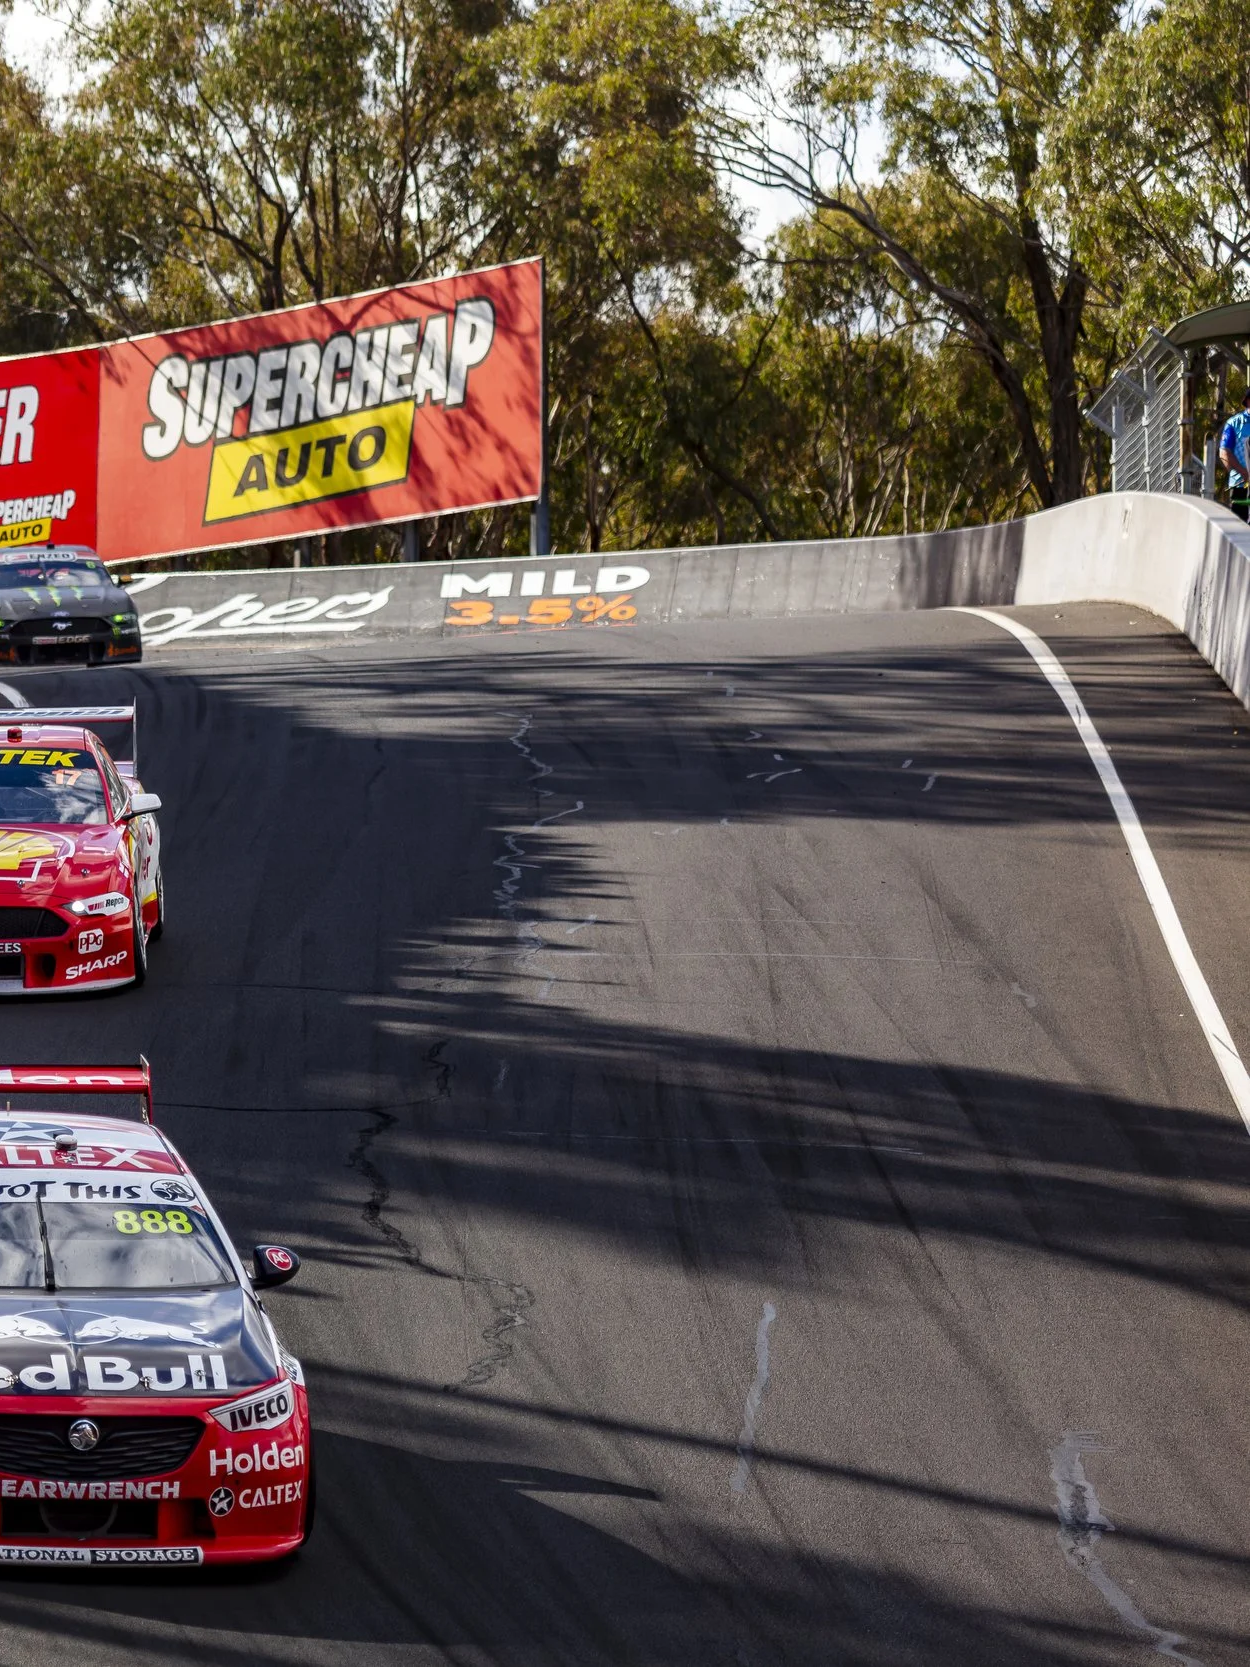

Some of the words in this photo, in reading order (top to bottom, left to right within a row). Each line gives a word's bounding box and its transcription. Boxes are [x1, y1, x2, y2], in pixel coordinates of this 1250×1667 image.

[142, 296, 496, 461] SUPERCHEAP
[233, 426, 387, 497] AUTO
[440, 566, 651, 598] MILD
[444, 594, 637, 625] 3.5%
[52, 769, 83, 786] 17
[105, 897, 125, 908] Repco
[79, 932, 103, 952] PPG
[65, 950, 128, 980] SHARP
[114, 1210, 193, 1235] 888
[83, 1354, 229, 1392] Bull
[229, 1394, 289, 1431] IVECO
[209, 1441, 304, 1477] Holden
[238, 1480, 302, 1509] CALTEX
[95, 1547, 195, 1563] STORAGE
